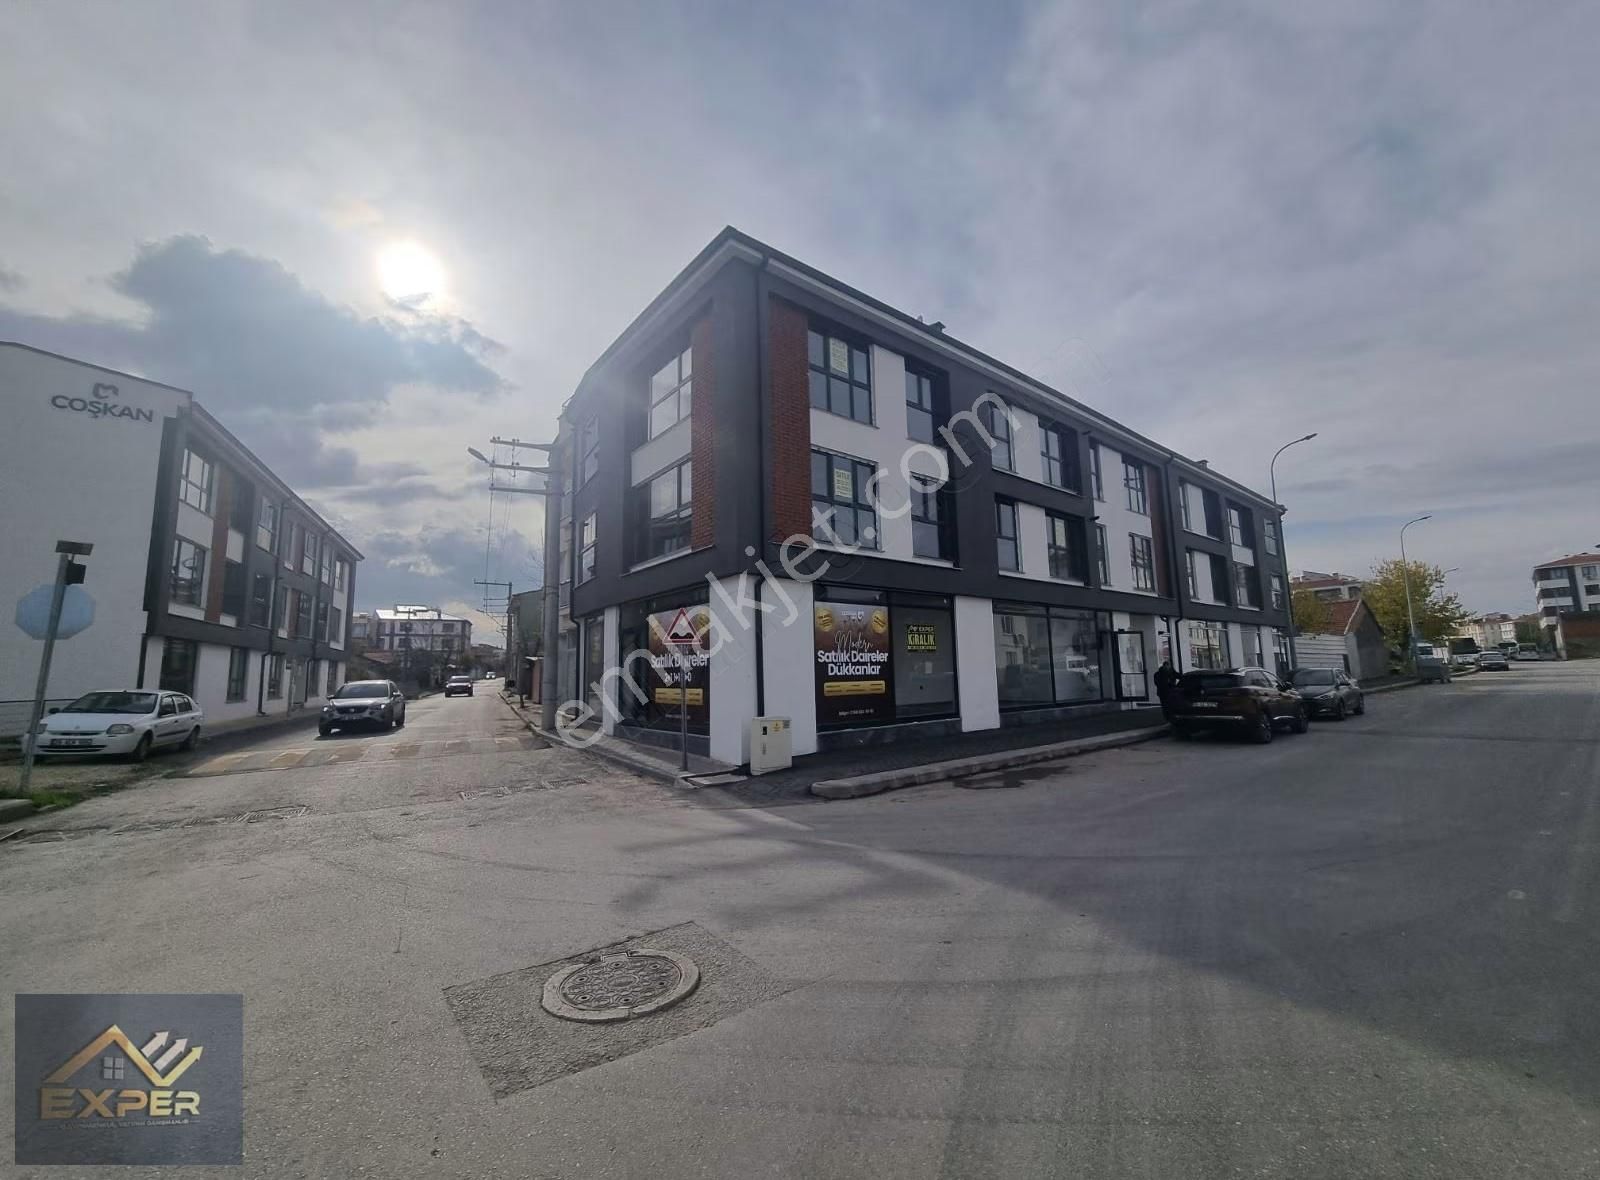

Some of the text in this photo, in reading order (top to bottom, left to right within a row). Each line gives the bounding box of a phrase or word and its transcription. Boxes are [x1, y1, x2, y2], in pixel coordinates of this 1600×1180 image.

[51, 395, 153, 422] COŞKAN
[851, 650, 888, 663] Daireler
[828, 663, 881, 676] Dükkanlar
